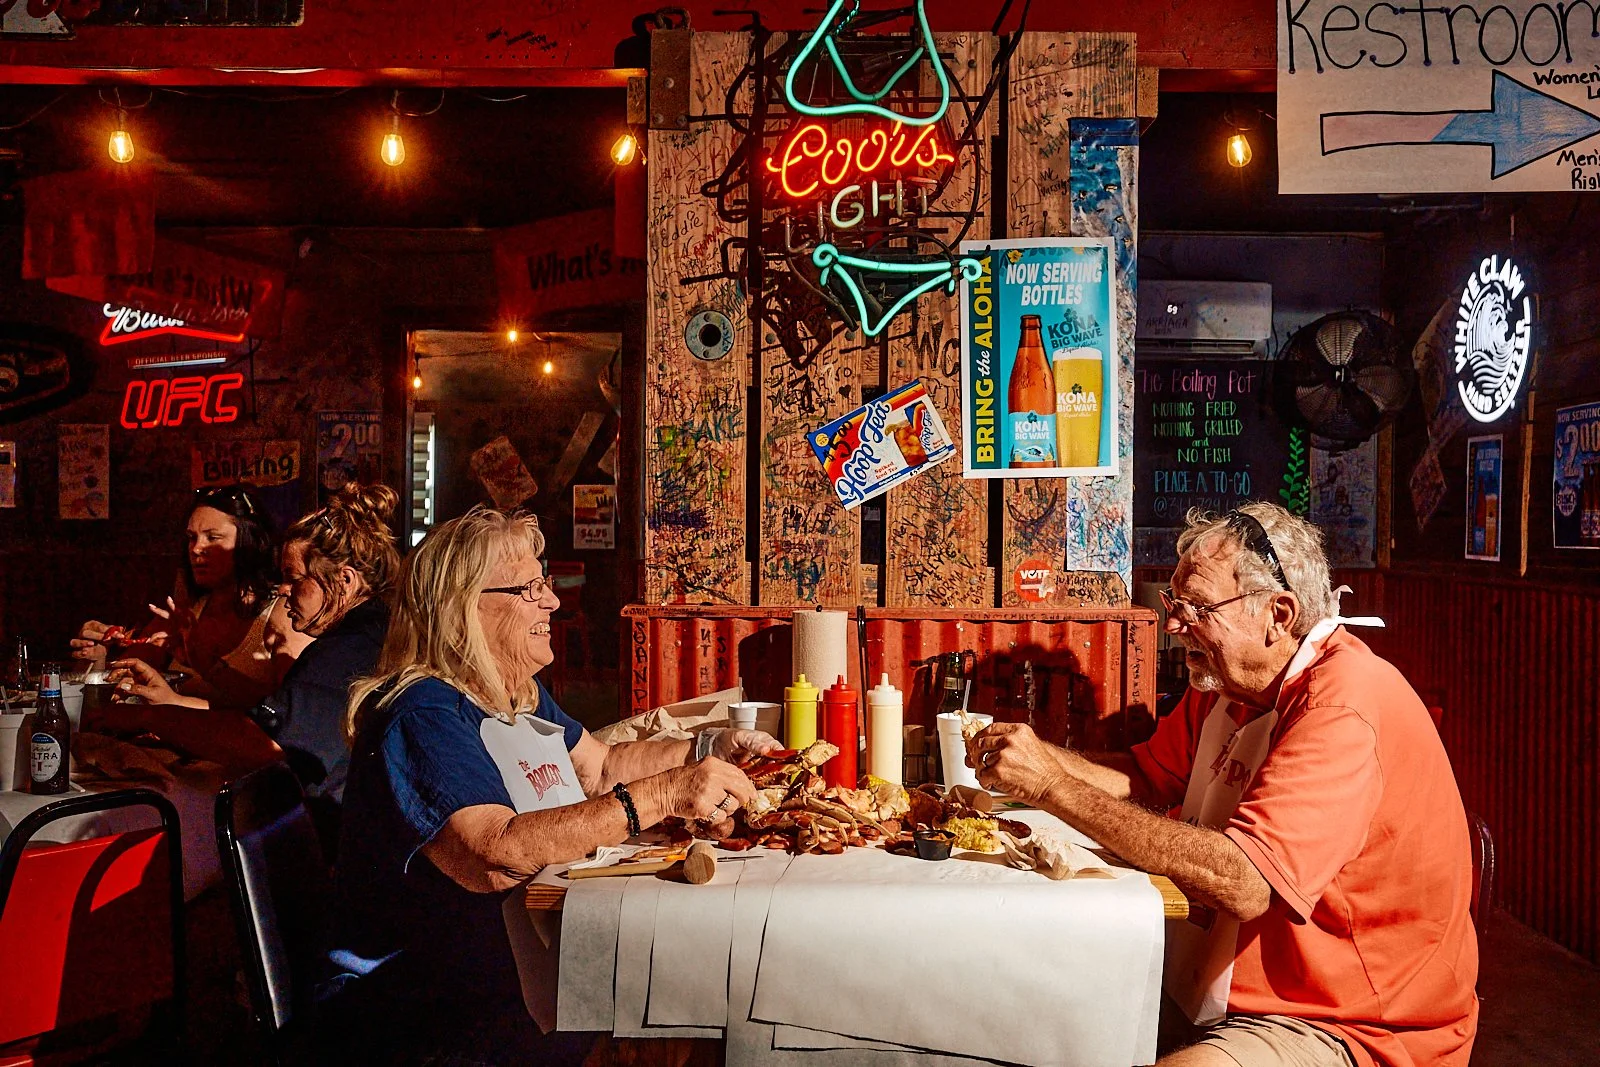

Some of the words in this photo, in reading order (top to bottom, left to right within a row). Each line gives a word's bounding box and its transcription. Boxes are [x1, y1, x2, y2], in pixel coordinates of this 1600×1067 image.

[1006, 263, 1040, 285] NOW
[1042, 262, 1103, 284] SERVING
[973, 256, 993, 350] ALOHA
[1021, 284, 1084, 306] BOTTLES
[1455, 272, 1480, 374] WHITE
[1480, 254, 1525, 301] CLAW
[1047, 313, 1100, 339] KONA
[1051, 336, 1071, 349] BIG
[1072, 327, 1103, 343] WAVE
[977, 350, 991, 377] the
[1172, 369, 1218, 400] Boiling
[1229, 370, 1257, 394] Pot
[120, 372, 244, 430] UFC
[1056, 392, 1097, 405] KONA
[1056, 404, 1072, 413] BIG
[1073, 403, 1097, 412] WAVE
[1152, 402, 1195, 417] NOTHING
[1206, 400, 1237, 417] FRIED
[1466, 381, 1493, 413] HARD
[975, 378, 994, 463] BRING
[1014, 420, 1049, 433] KONA
[1153, 421, 1195, 437] NOTHING
[1014, 432, 1028, 441] BIG
[1028, 431, 1050, 440] WAVE
[1192, 438, 1210, 448] and
[1177, 448, 1199, 464] NO
[1204, 447, 1231, 464] FISH
[837, 443, 882, 501] Hoop
[1154, 470, 1192, 493] PLACE
[1195, 471, 1208, 493] A
[927, 570, 964, 604] NORMA
